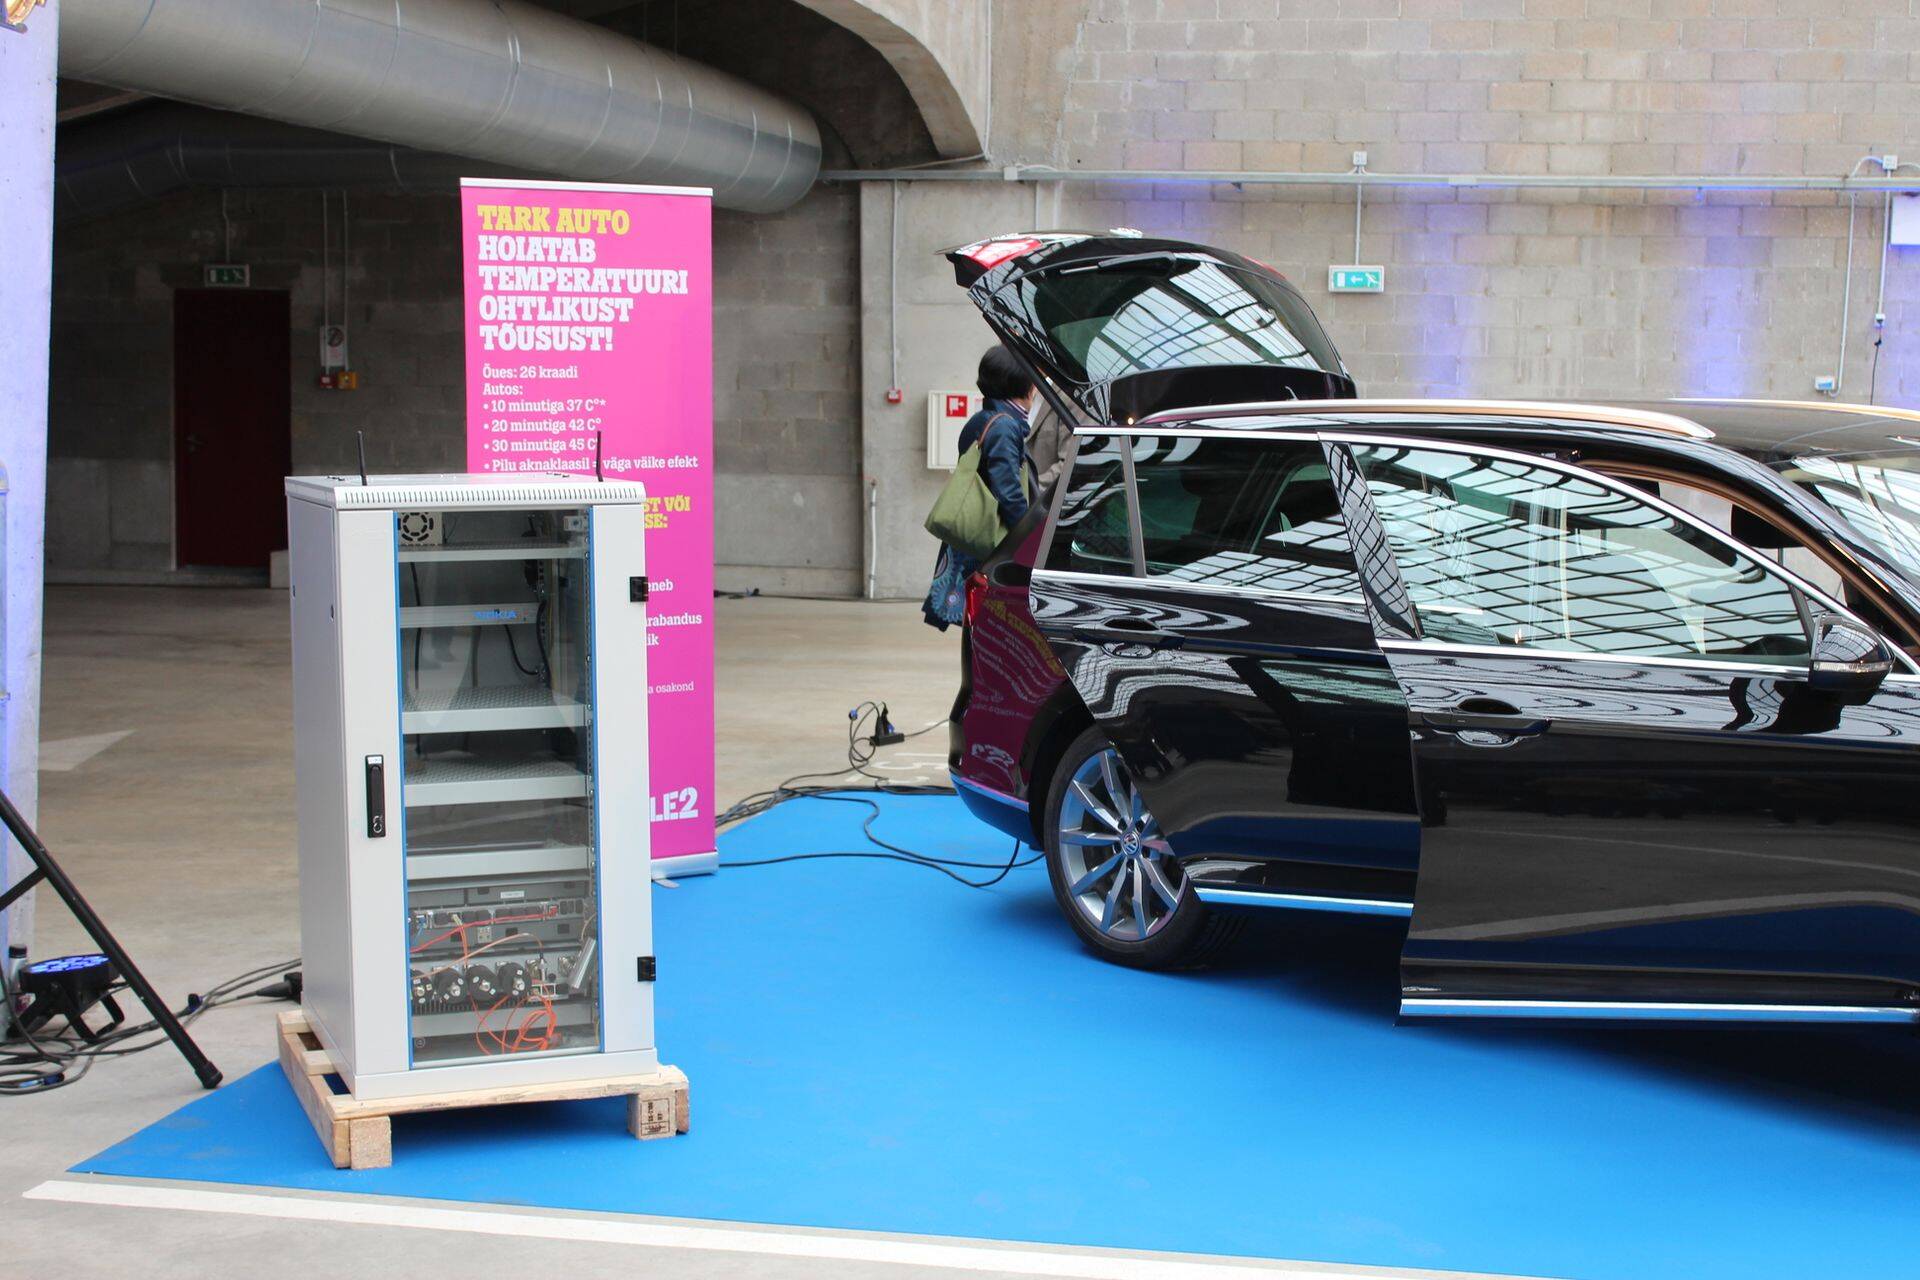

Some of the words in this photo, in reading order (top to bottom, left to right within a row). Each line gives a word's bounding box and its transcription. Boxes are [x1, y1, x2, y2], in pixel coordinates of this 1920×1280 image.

[477, 205, 550, 232] TARK
[556, 208, 629, 235] AUTO
[479, 235, 596, 263] HOIATAB
[479, 265, 688, 294] TEMPERATUURI
[479, 295, 633, 322] OHTLIKUST
[480, 323, 613, 351] TÕUSUST!
[483, 363, 517, 378] Õues:
[520, 366, 536, 378] 26
[539, 366, 578, 378] kraadi
[483, 383, 522, 395] Autos:
[492, 400, 506, 412] 10
[508, 400, 564, 414] minutiga
[567, 399, 582, 411] 37
[492, 420, 508, 432] 20
[510, 419, 566, 434] minutiga
[569, 419, 584, 430] 42
[492, 440, 508, 452] 30
[511, 439, 566, 454] minutiga
[569, 438, 584, 450] 45
[587, 438, 597, 450] C
[493, 459, 518, 473] Pilu
[519, 458, 590, 472] aknaklaasil
[603, 457, 631, 472] väga
[634, 456, 665, 468] väike
[668, 456, 698, 468] efekt
[664, 495, 690, 511] VÕI
[646, 613, 702, 627] rabandus
[656, 681, 694, 693] osakond
